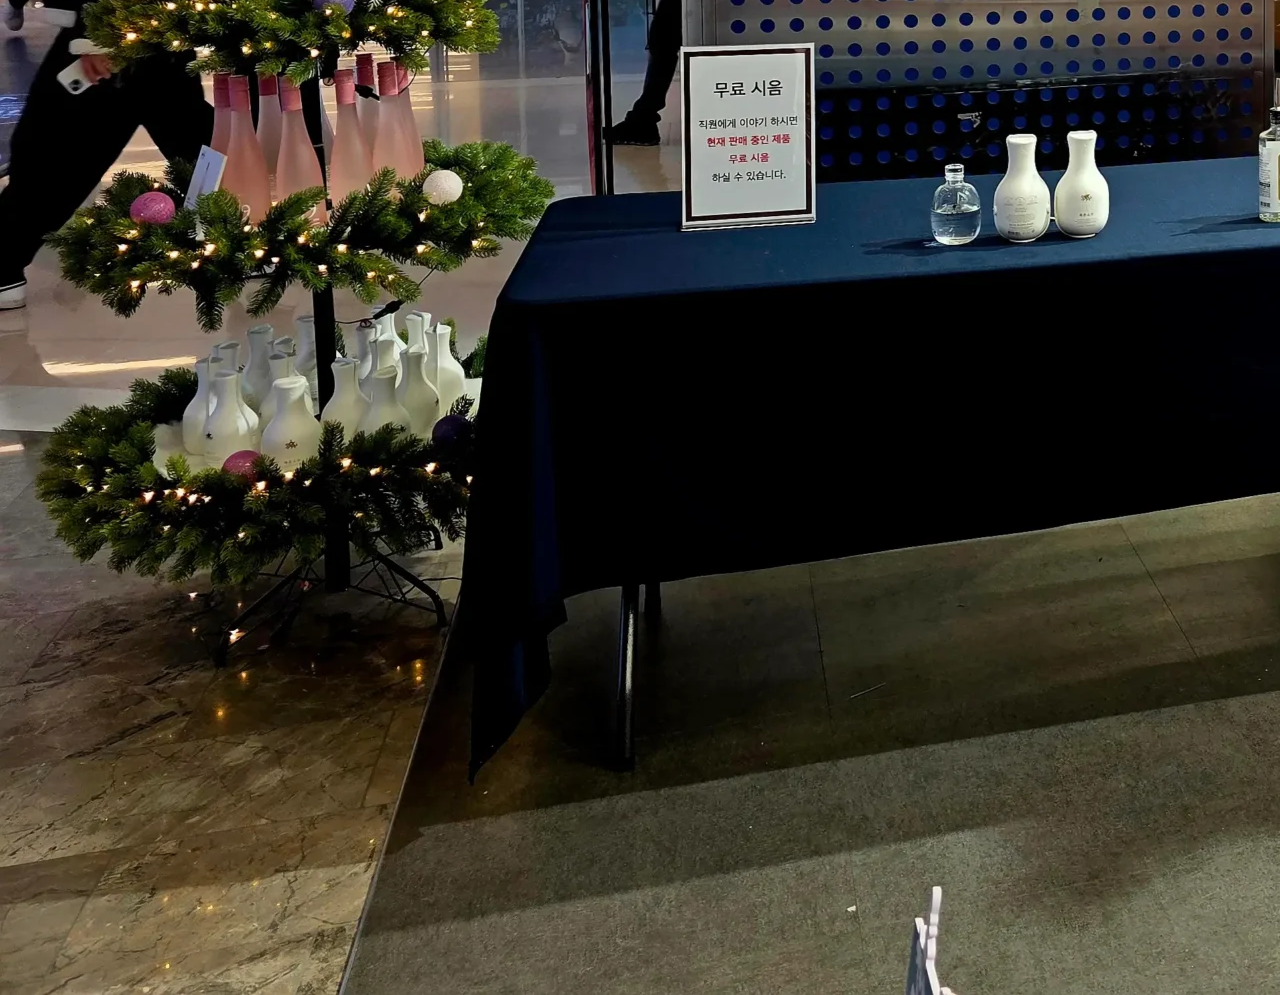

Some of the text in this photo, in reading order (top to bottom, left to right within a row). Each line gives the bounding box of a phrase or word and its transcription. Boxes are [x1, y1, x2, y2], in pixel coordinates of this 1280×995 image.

[713, 79, 783, 98] 무료 시음
[698, 115, 799, 130] 직원에게 이야기 하시면
[706, 133, 791, 147] 현재 판매 중인 제품
[728, 152, 769, 164] 무료 시음
[711, 169, 787, 183] 하실 수 있습니다.
